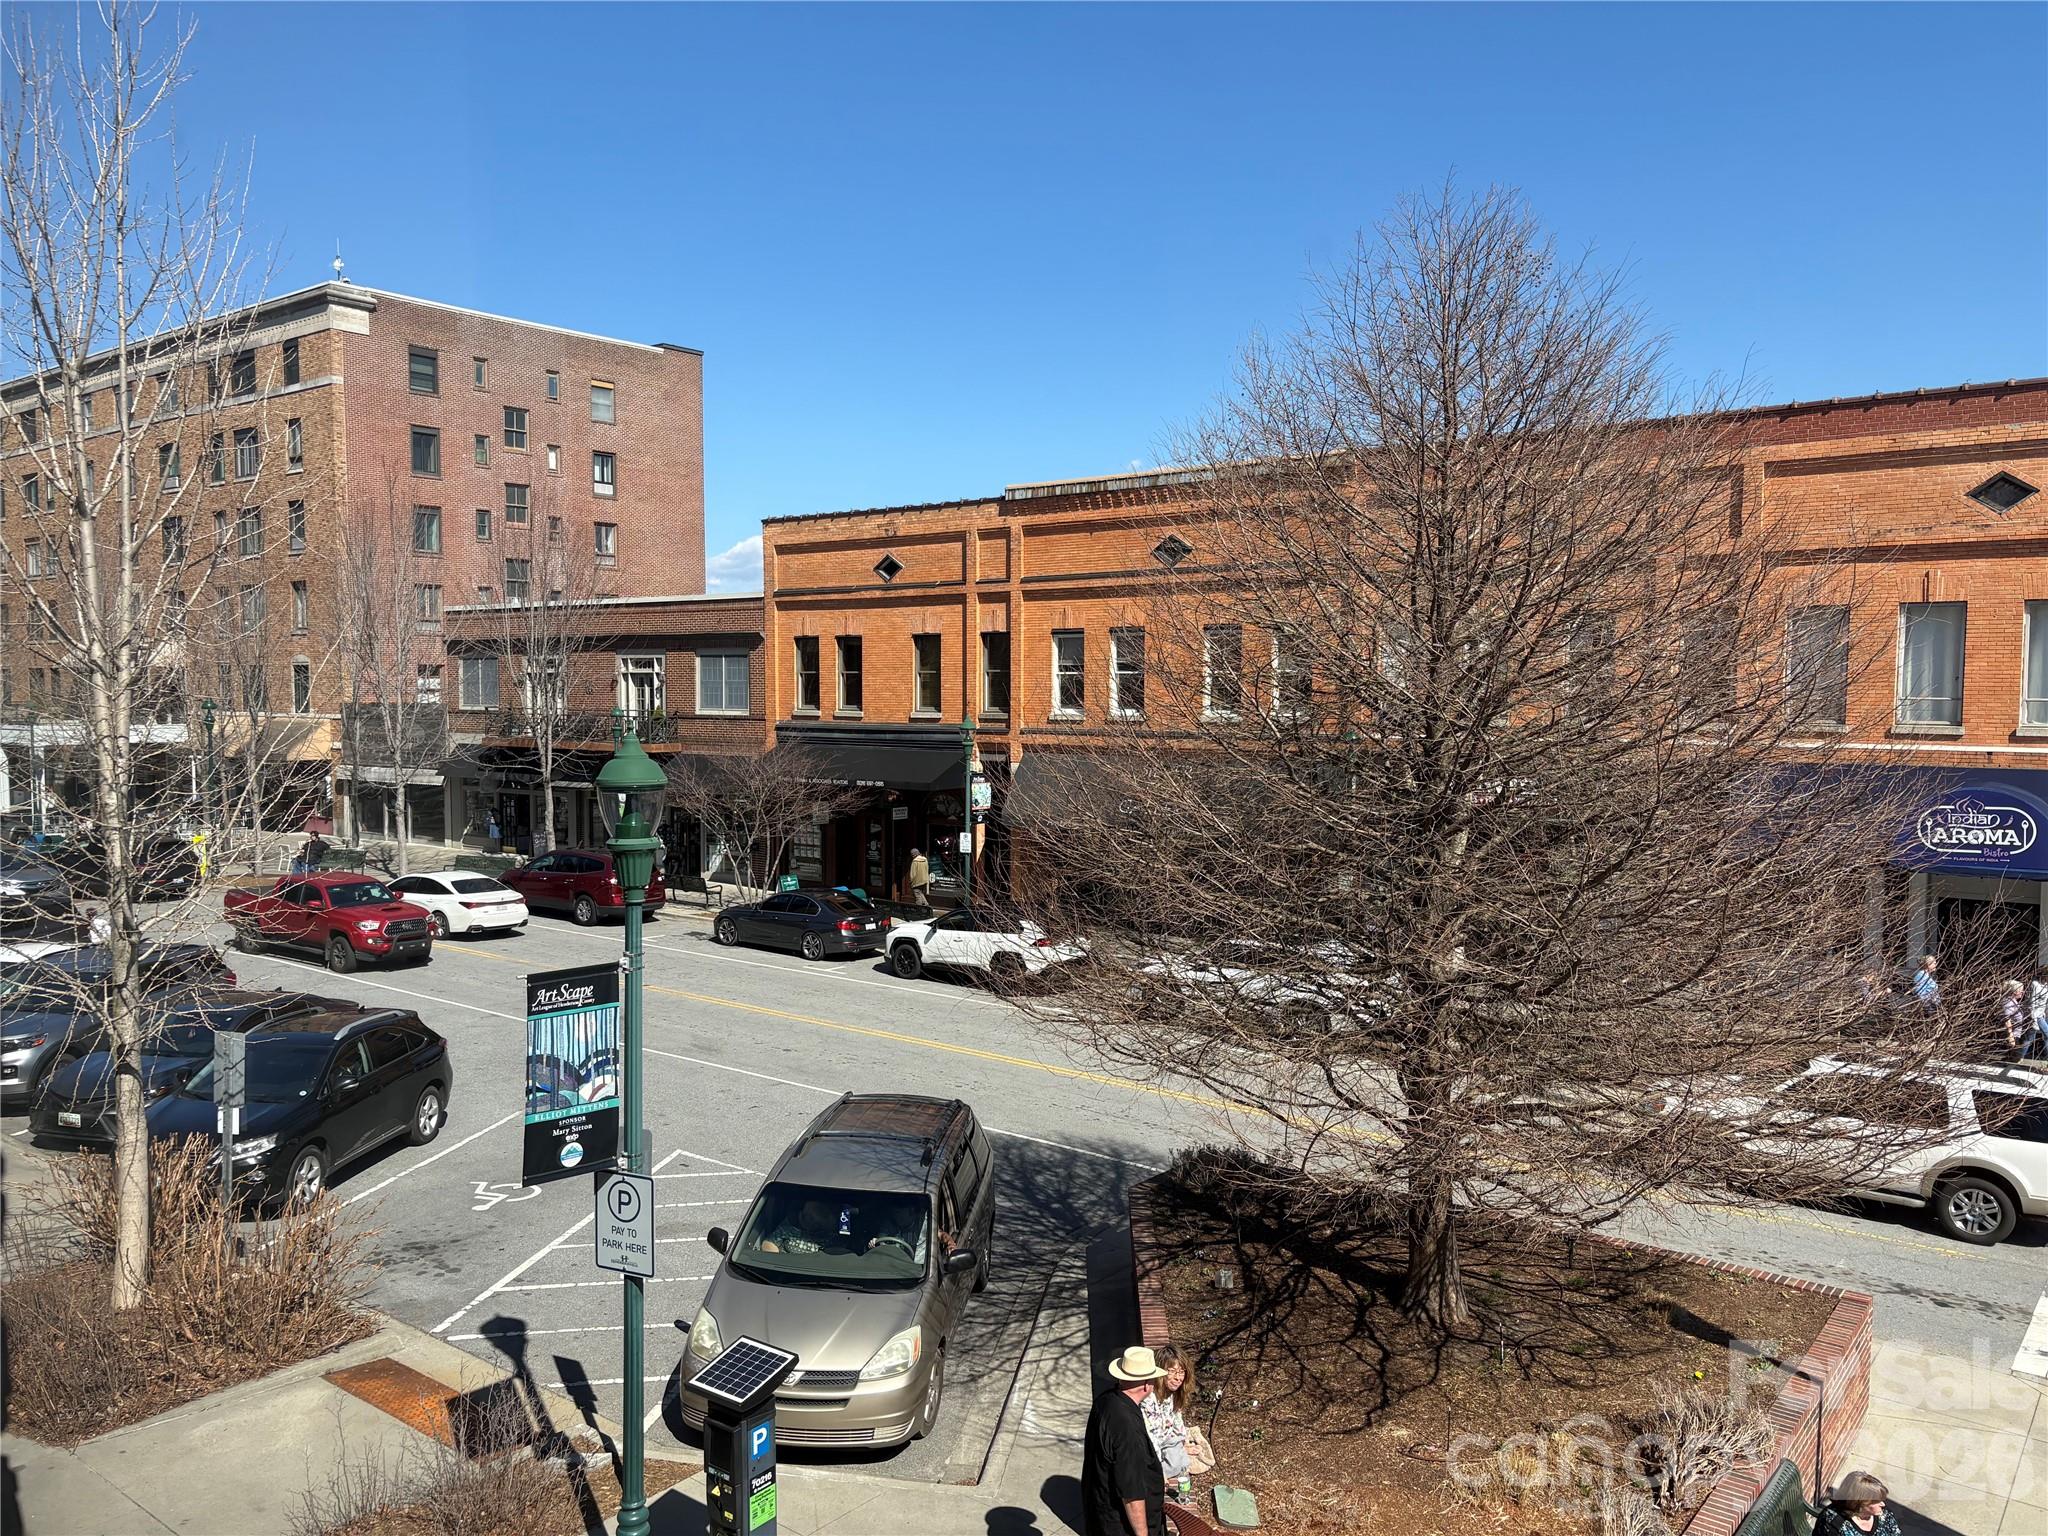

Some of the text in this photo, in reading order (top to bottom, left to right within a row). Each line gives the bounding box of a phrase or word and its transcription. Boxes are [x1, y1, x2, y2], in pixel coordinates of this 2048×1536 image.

[1946, 807, 2001, 828] Indian
[1931, 827, 2022, 846] AROMA
[1983, 847, 2009, 857] Bistro
[535, 1101, 609, 1121] ELLIOT MITTENS
[558, 1115, 586, 1126] SPONSOR
[552, 1123, 593, 1137] Mary Sitton
[618, 1189, 632, 1215] P
[611, 1225, 637, 1239] PAY TO
[602, 1237, 648, 1255] PARK HERE
[752, 1427, 768, 1456] P
